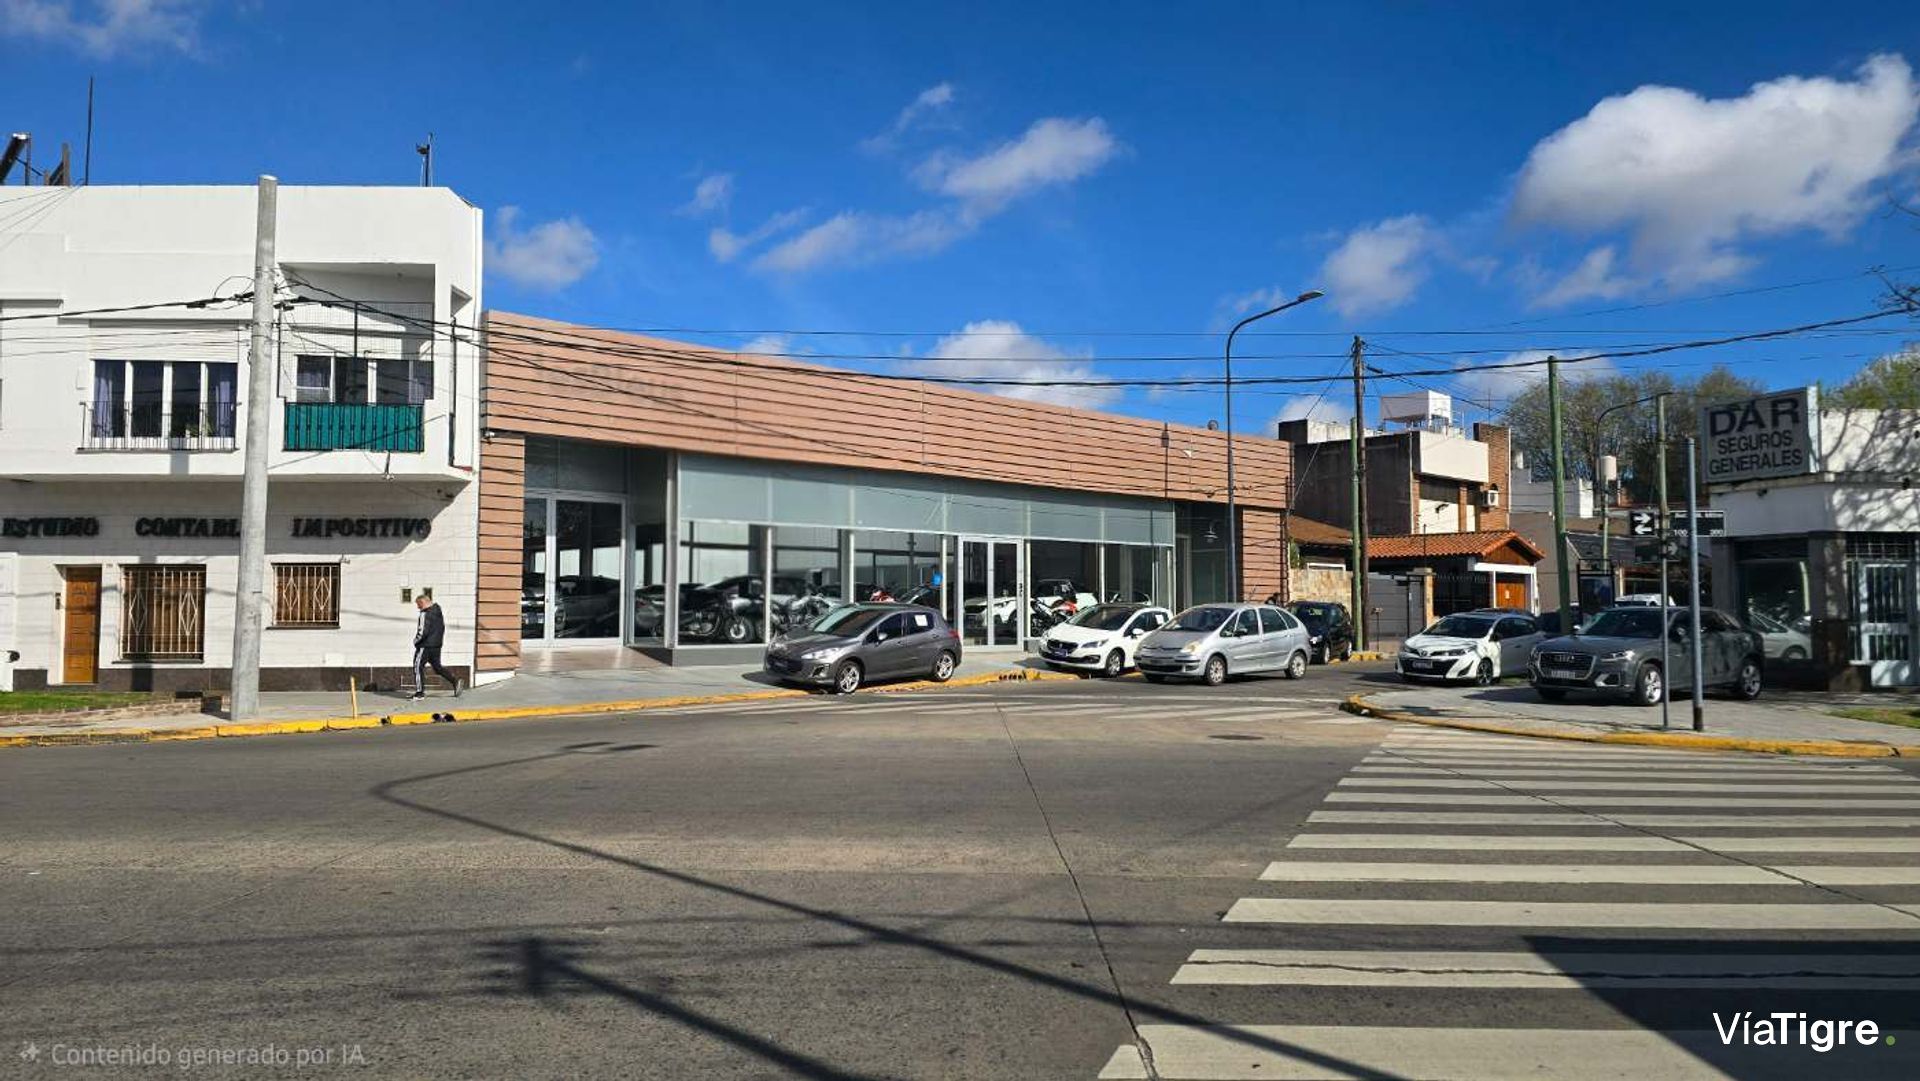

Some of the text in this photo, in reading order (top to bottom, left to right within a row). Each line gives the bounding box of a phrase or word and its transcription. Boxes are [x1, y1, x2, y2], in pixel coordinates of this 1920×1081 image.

[1709, 398, 1800, 437] DAR
[1717, 429, 1794, 455] SEGUROS
[1709, 448, 1803, 475] GENERALES
[2, 517, 432, 539] ESTUDIO CONTABL IMPOSITIVO
